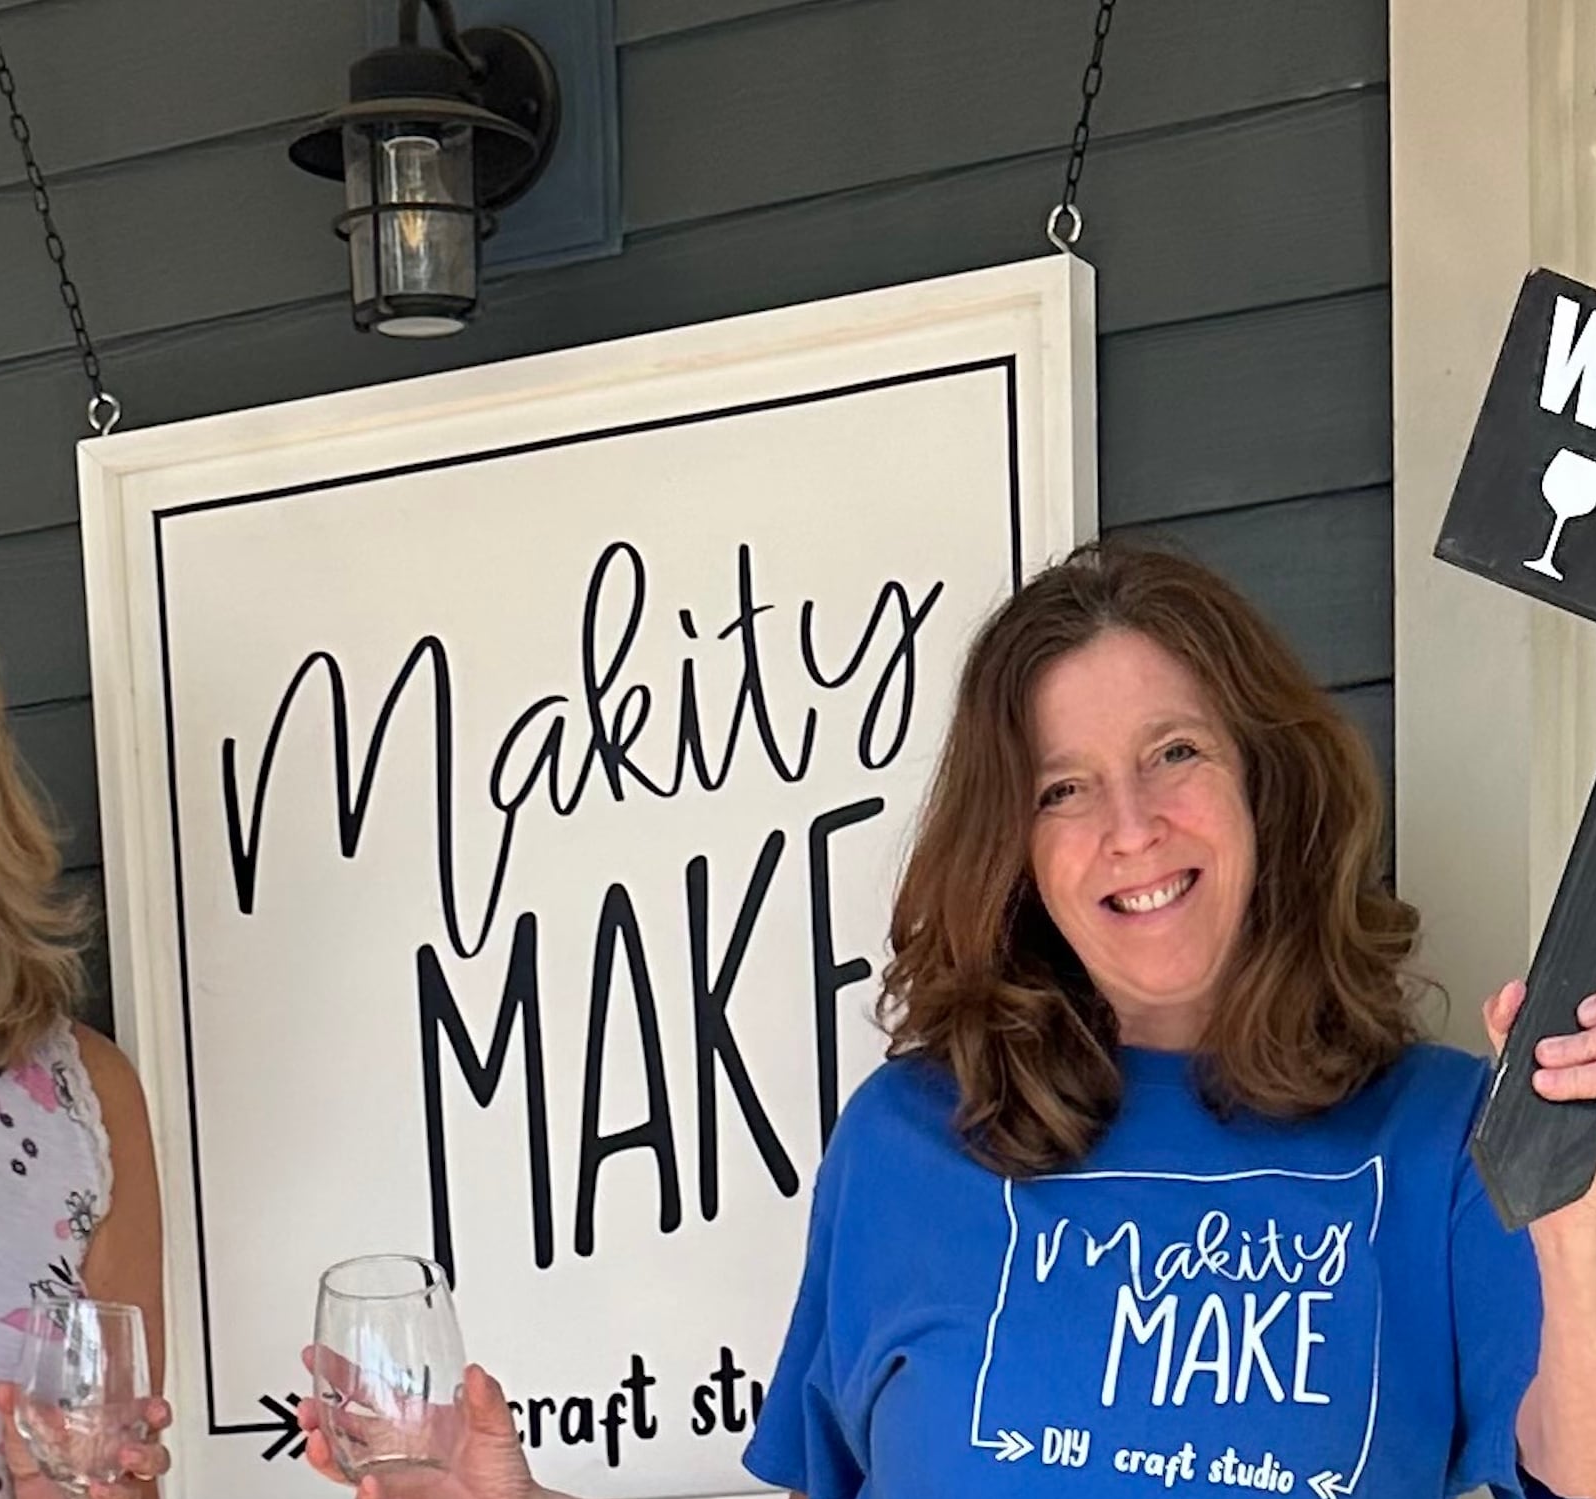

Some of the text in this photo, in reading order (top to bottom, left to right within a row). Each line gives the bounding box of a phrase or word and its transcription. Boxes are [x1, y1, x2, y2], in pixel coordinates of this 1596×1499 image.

[223, 541, 945, 959] Makity
[1036, 1209, 1352, 1301] Makity
[1101, 1286, 1333, 1409] MAKE
[1042, 1427, 1295, 1495] DIY craft studio
